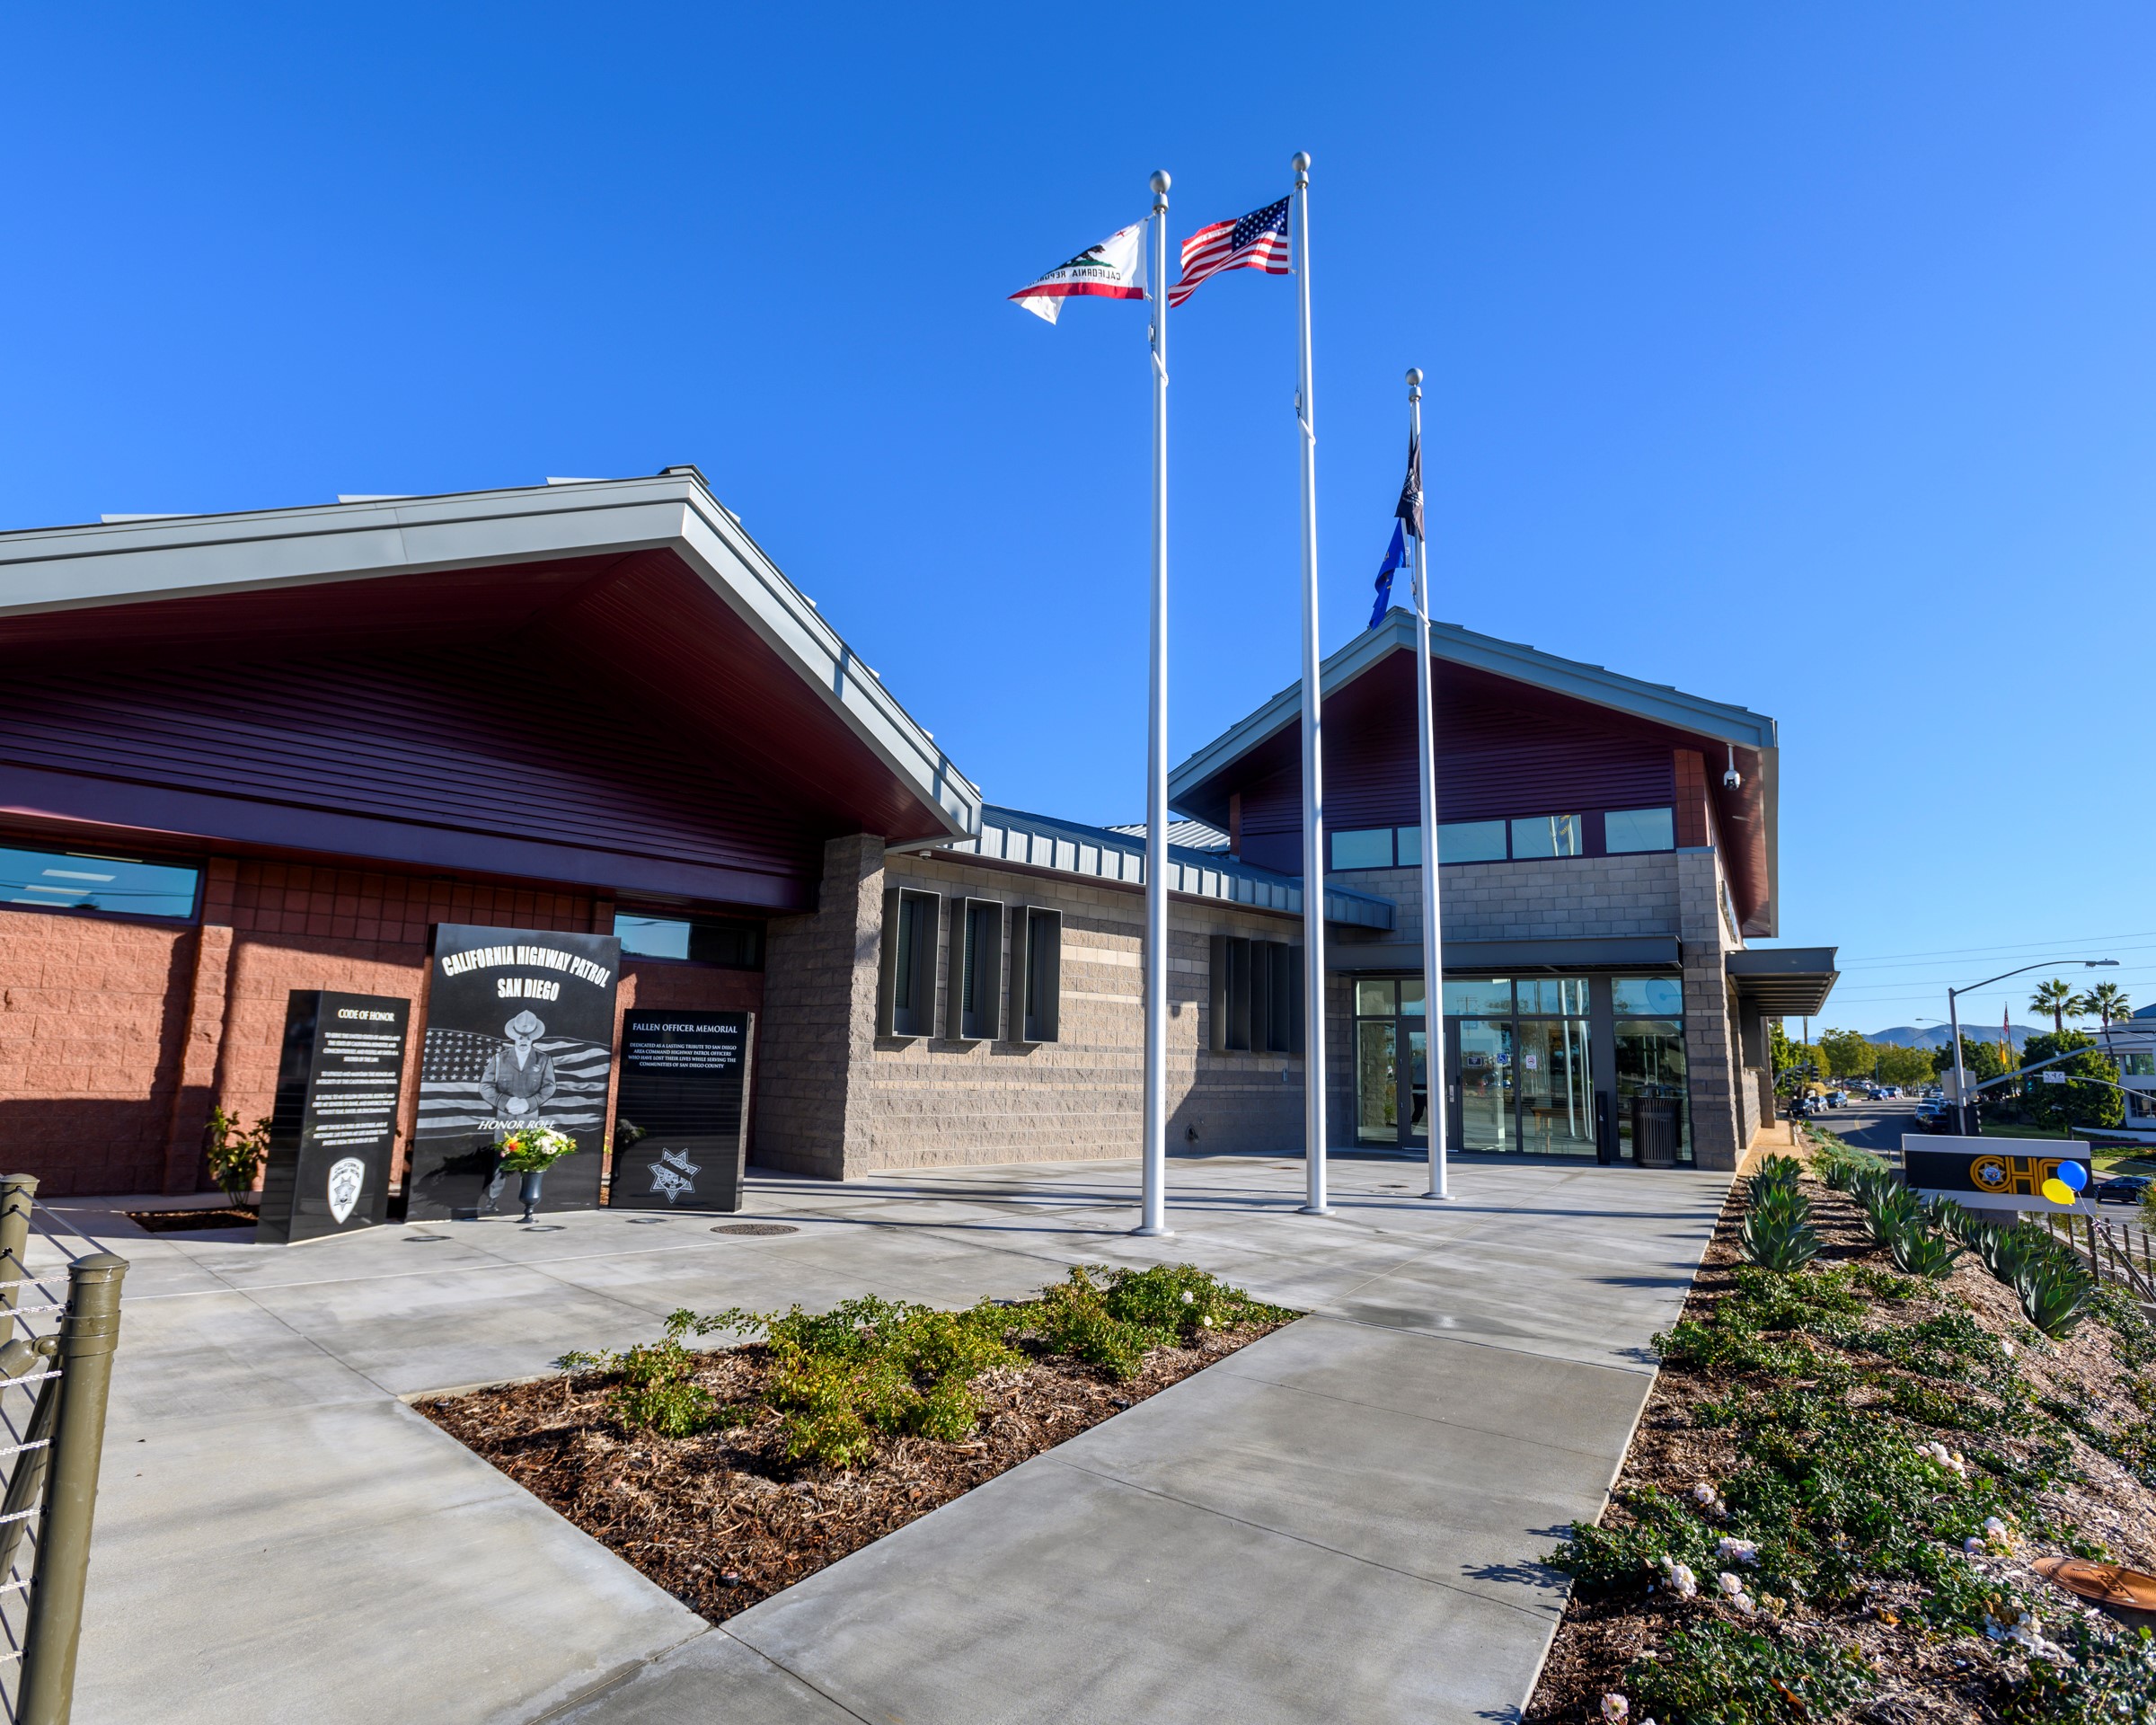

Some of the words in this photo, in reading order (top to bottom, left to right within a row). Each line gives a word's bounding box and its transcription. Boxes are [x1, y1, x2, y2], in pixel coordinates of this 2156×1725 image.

[441, 945, 515, 977] CALIFORNIA
[517, 945, 572, 972] HIGHWAY
[569, 956, 611, 988] PATROL
[497, 978, 522, 998] SAN
[523, 978, 561, 1002] DIEGO
[338, 1008, 359, 1020] CODE
[359, 1010, 369, 1021] OF
[368, 1012, 395, 1022] HONOR
[632, 1022, 660, 1031] FALLEN
[662, 1024, 694, 1032] OFFICER
[695, 1024, 738, 1033] MEMORIAL
[477, 1119, 524, 1129] HONOR
[526, 1119, 556, 1129] ROLL
